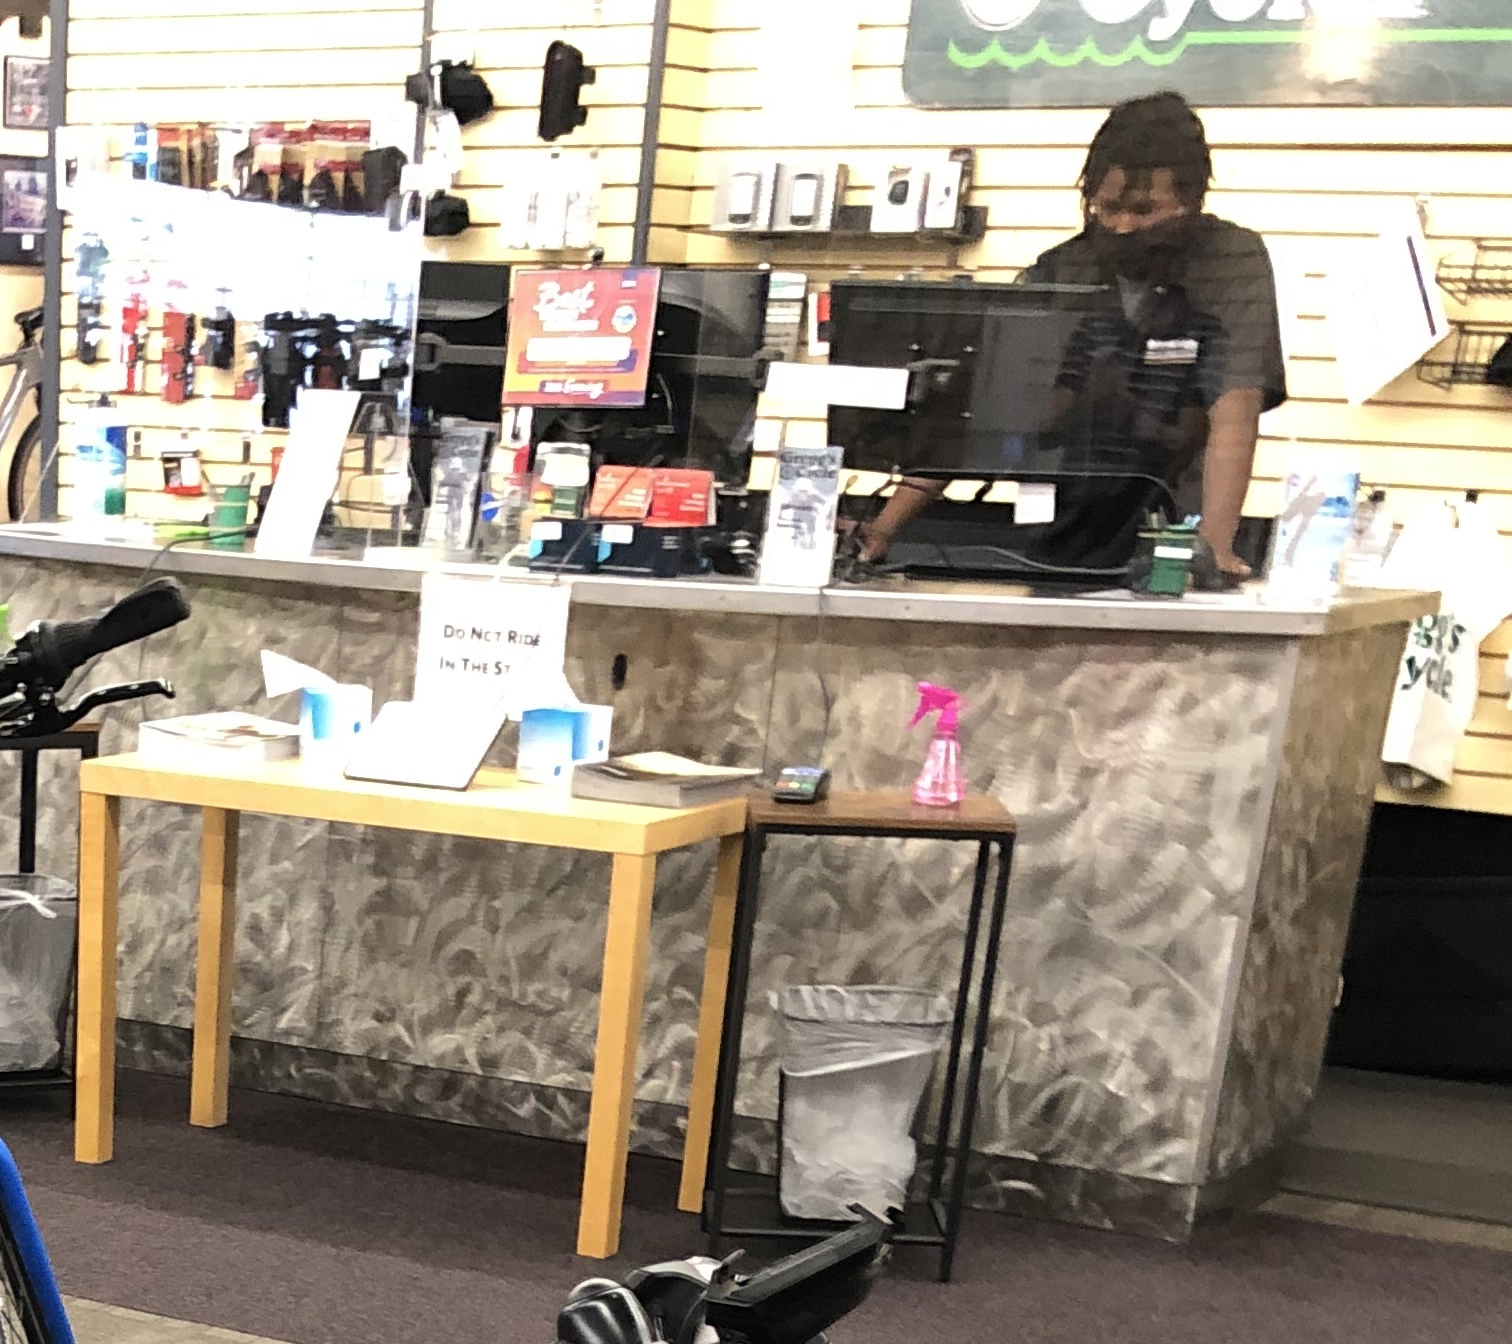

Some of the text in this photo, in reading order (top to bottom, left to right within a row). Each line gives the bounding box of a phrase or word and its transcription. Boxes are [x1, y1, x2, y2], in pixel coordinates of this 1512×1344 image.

[443, 623, 466, 640] DO
[439, 655, 456, 671] IN
[461, 657, 489, 675] THE
